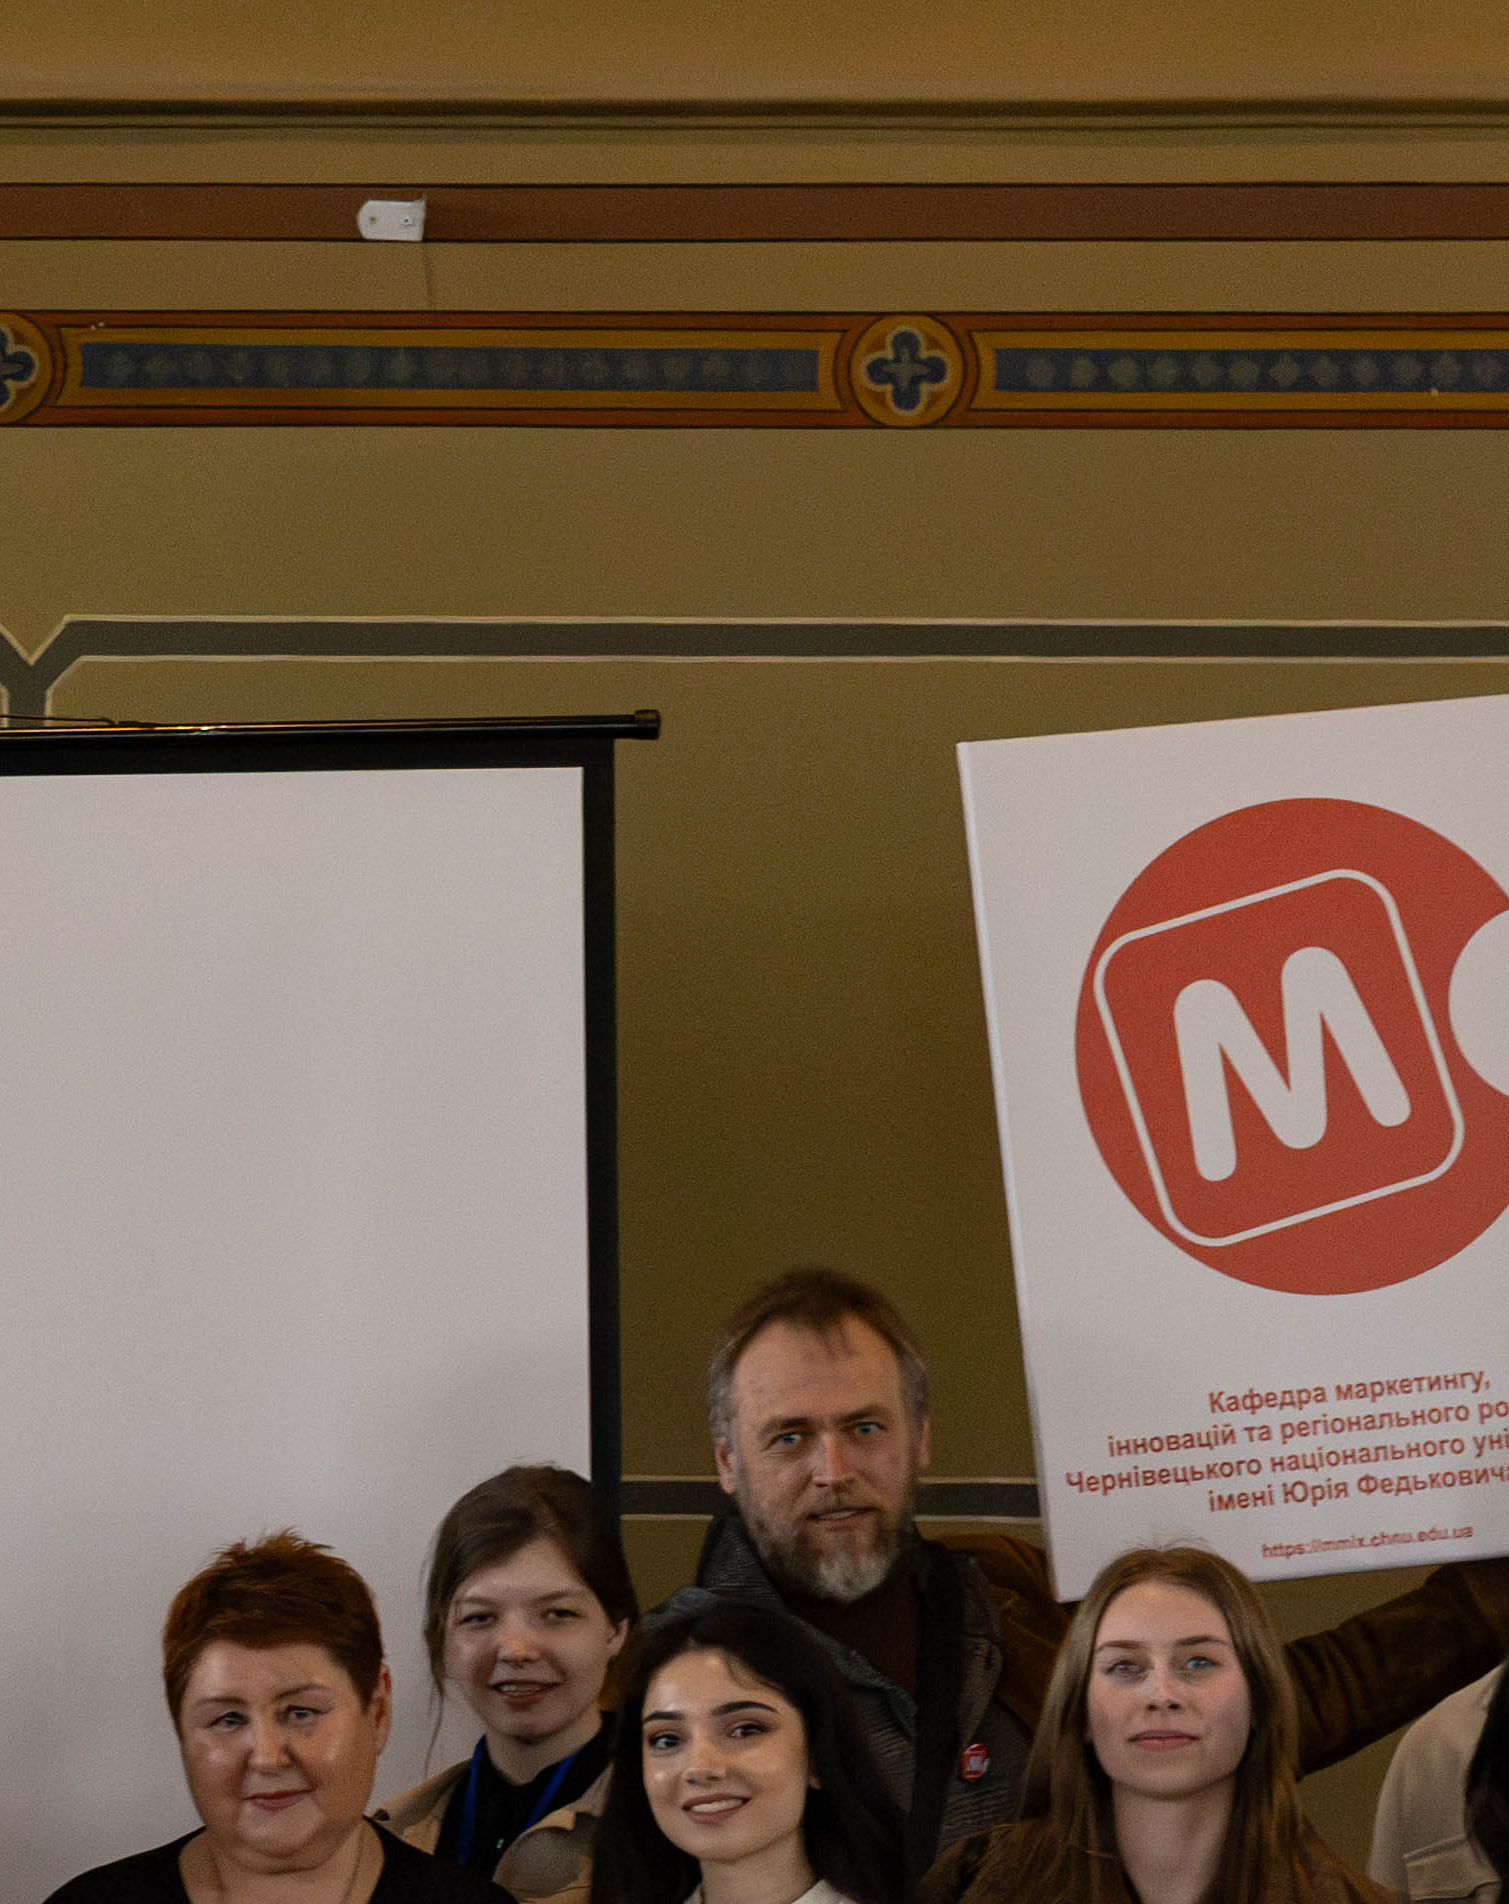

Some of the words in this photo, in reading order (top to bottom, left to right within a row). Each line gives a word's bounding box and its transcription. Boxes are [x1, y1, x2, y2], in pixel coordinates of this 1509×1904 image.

[1208, 1385, 1326, 1415] Кафедра
[1335, 1370, 1490, 1402] маркетингу,
[1107, 1423, 1236, 1457] інновацій
[1243, 1424, 1273, 1443] та
[1280, 1404, 1470, 1444] регіонального
[1065, 1457, 1262, 1496] Чернівецького
[1269, 1436, 1465, 1473] національного
[1208, 1484, 1275, 1513] імені
[1282, 1478, 1349, 1508] Юрія
